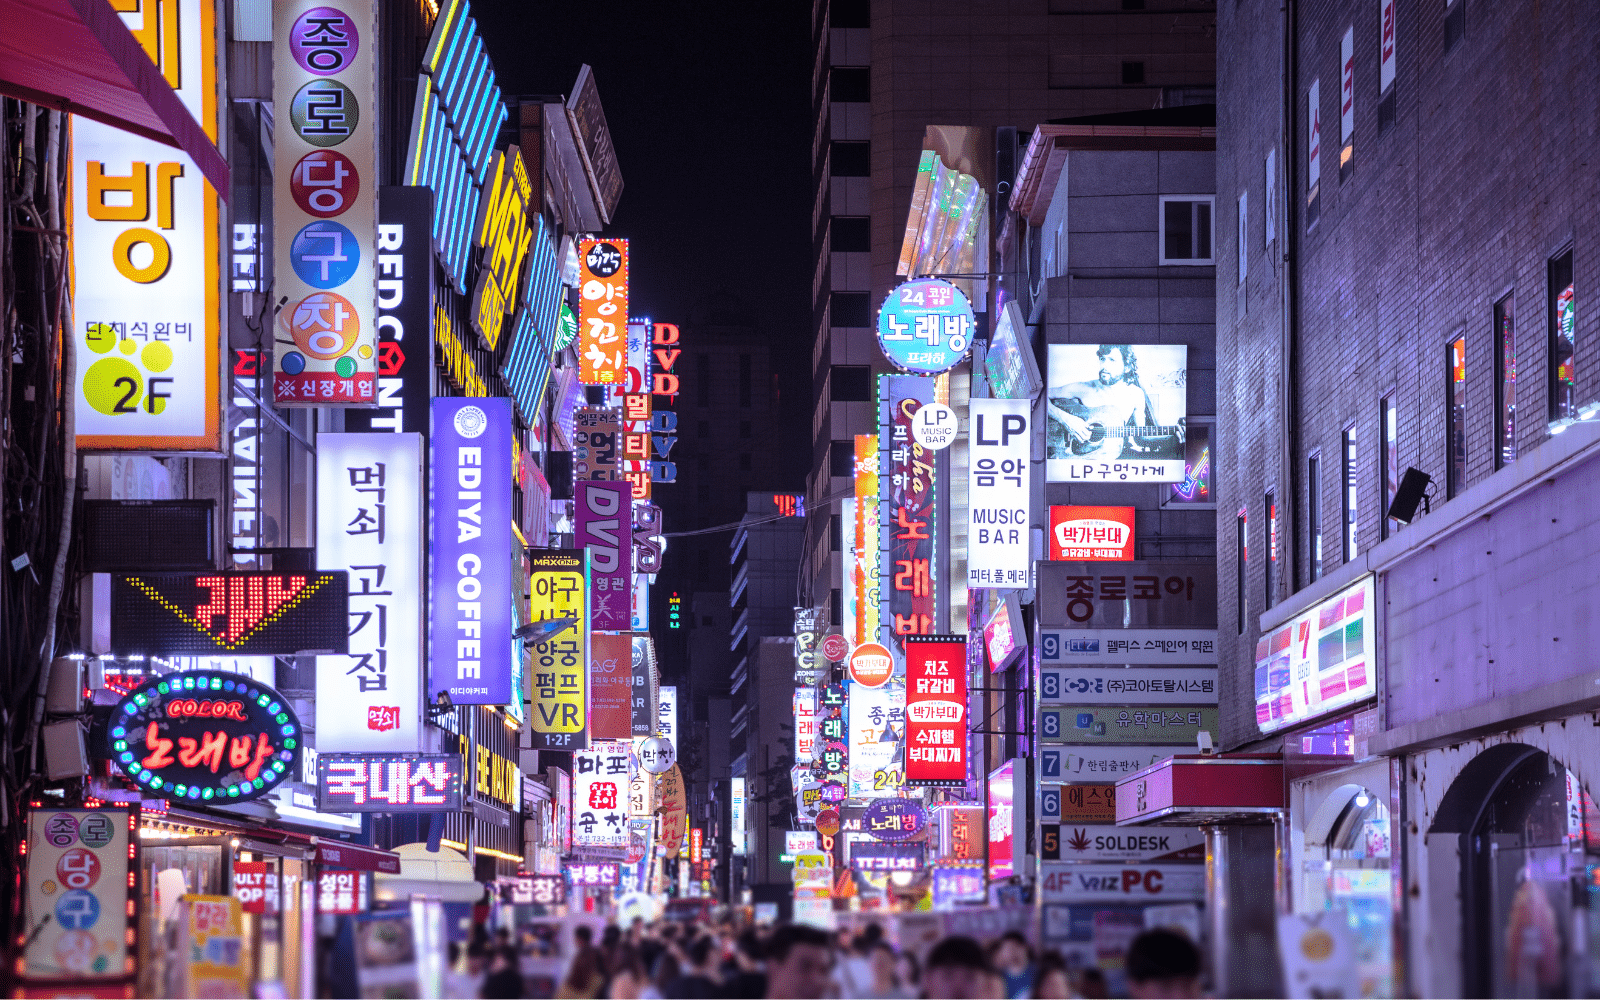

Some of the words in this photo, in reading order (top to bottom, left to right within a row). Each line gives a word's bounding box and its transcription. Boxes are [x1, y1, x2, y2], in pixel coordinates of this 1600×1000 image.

[901, 288, 925, 306] 24
[928, 287, 951, 299] 코인
[86, 321, 192, 342] 단체석완비
[883, 313, 971, 352] 노래방
[652, 323, 682, 395] DVD
[906, 352, 946, 365] 프라하
[112, 376, 174, 414] 2F
[301, 379, 373, 398] 신장개업
[924, 410, 948, 426] LP
[921, 427, 952, 435] MUSIC
[976, 413, 1027, 447] LP
[651, 411, 678, 484] DVD
[891, 425, 911, 491] 프라하
[973, 458, 1026, 488] 음악
[1070, 465, 1094, 479] LP
[1097, 463, 1165, 480] 구멍가게
[457, 446, 482, 544] EDIYA
[973, 508, 1026, 525] MUSIC
[586, 485, 620, 574] DVD
[978, 528, 1019, 544] BAR
[1063, 527, 1122, 544] 박가부대
[536, 576, 580, 603] 야구
[1066, 575, 1195, 623] 종로코아
[457, 553, 482, 680] COFFEE
[536, 640, 580, 667] 양궁
[797, 632, 815, 669] PC
[1043, 637, 1058, 656] 9
[1107, 640, 1141, 653] 펠리스
[1143, 640, 1188, 653] 스페인어
[1191, 640, 1214, 653] 학원
[924, 660, 949, 676] 치즈
[450, 687, 488, 695] 이디야커피
[536, 672, 580, 699] 펌프
[632, 675, 645, 687] UB
[916, 678, 955, 694] 닭갈비
[1043, 676, 1058, 695] 8
[1064, 677, 1103, 693] CORE
[1107, 679, 1214, 694] (주)코아토탈시스템
[167, 698, 248, 721] COLOR
[369, 706, 400, 730] 먹쇠
[538, 703, 580, 727] VR
[913, 706, 958, 719] 박가부대
[799, 703, 814, 754] 노래방
[824, 688, 843, 771] 노래방
[1044, 715, 1058, 734] 8
[1116, 710, 1203, 729] 유학마스터
[142, 721, 274, 781] 노래방
[909, 747, 961, 763] 부대찌개
[578, 755, 627, 775] 마포
[1044, 755, 1058, 773] 7
[1087, 759, 1141, 773] 한림출판사
[326, 762, 452, 804] 국내산
[822, 788, 833, 800] 24
[1043, 793, 1057, 813] 6
[50, 818, 110, 846] 종로
[579, 811, 627, 834] 곱창
[871, 814, 917, 831] 노래방
[1044, 832, 1057, 851] 5
[1095, 836, 1170, 851] SOLDESK
[570, 865, 618, 886] 부동산
[1043, 871, 1072, 893] 4F
[1121, 869, 1164, 894] PC
